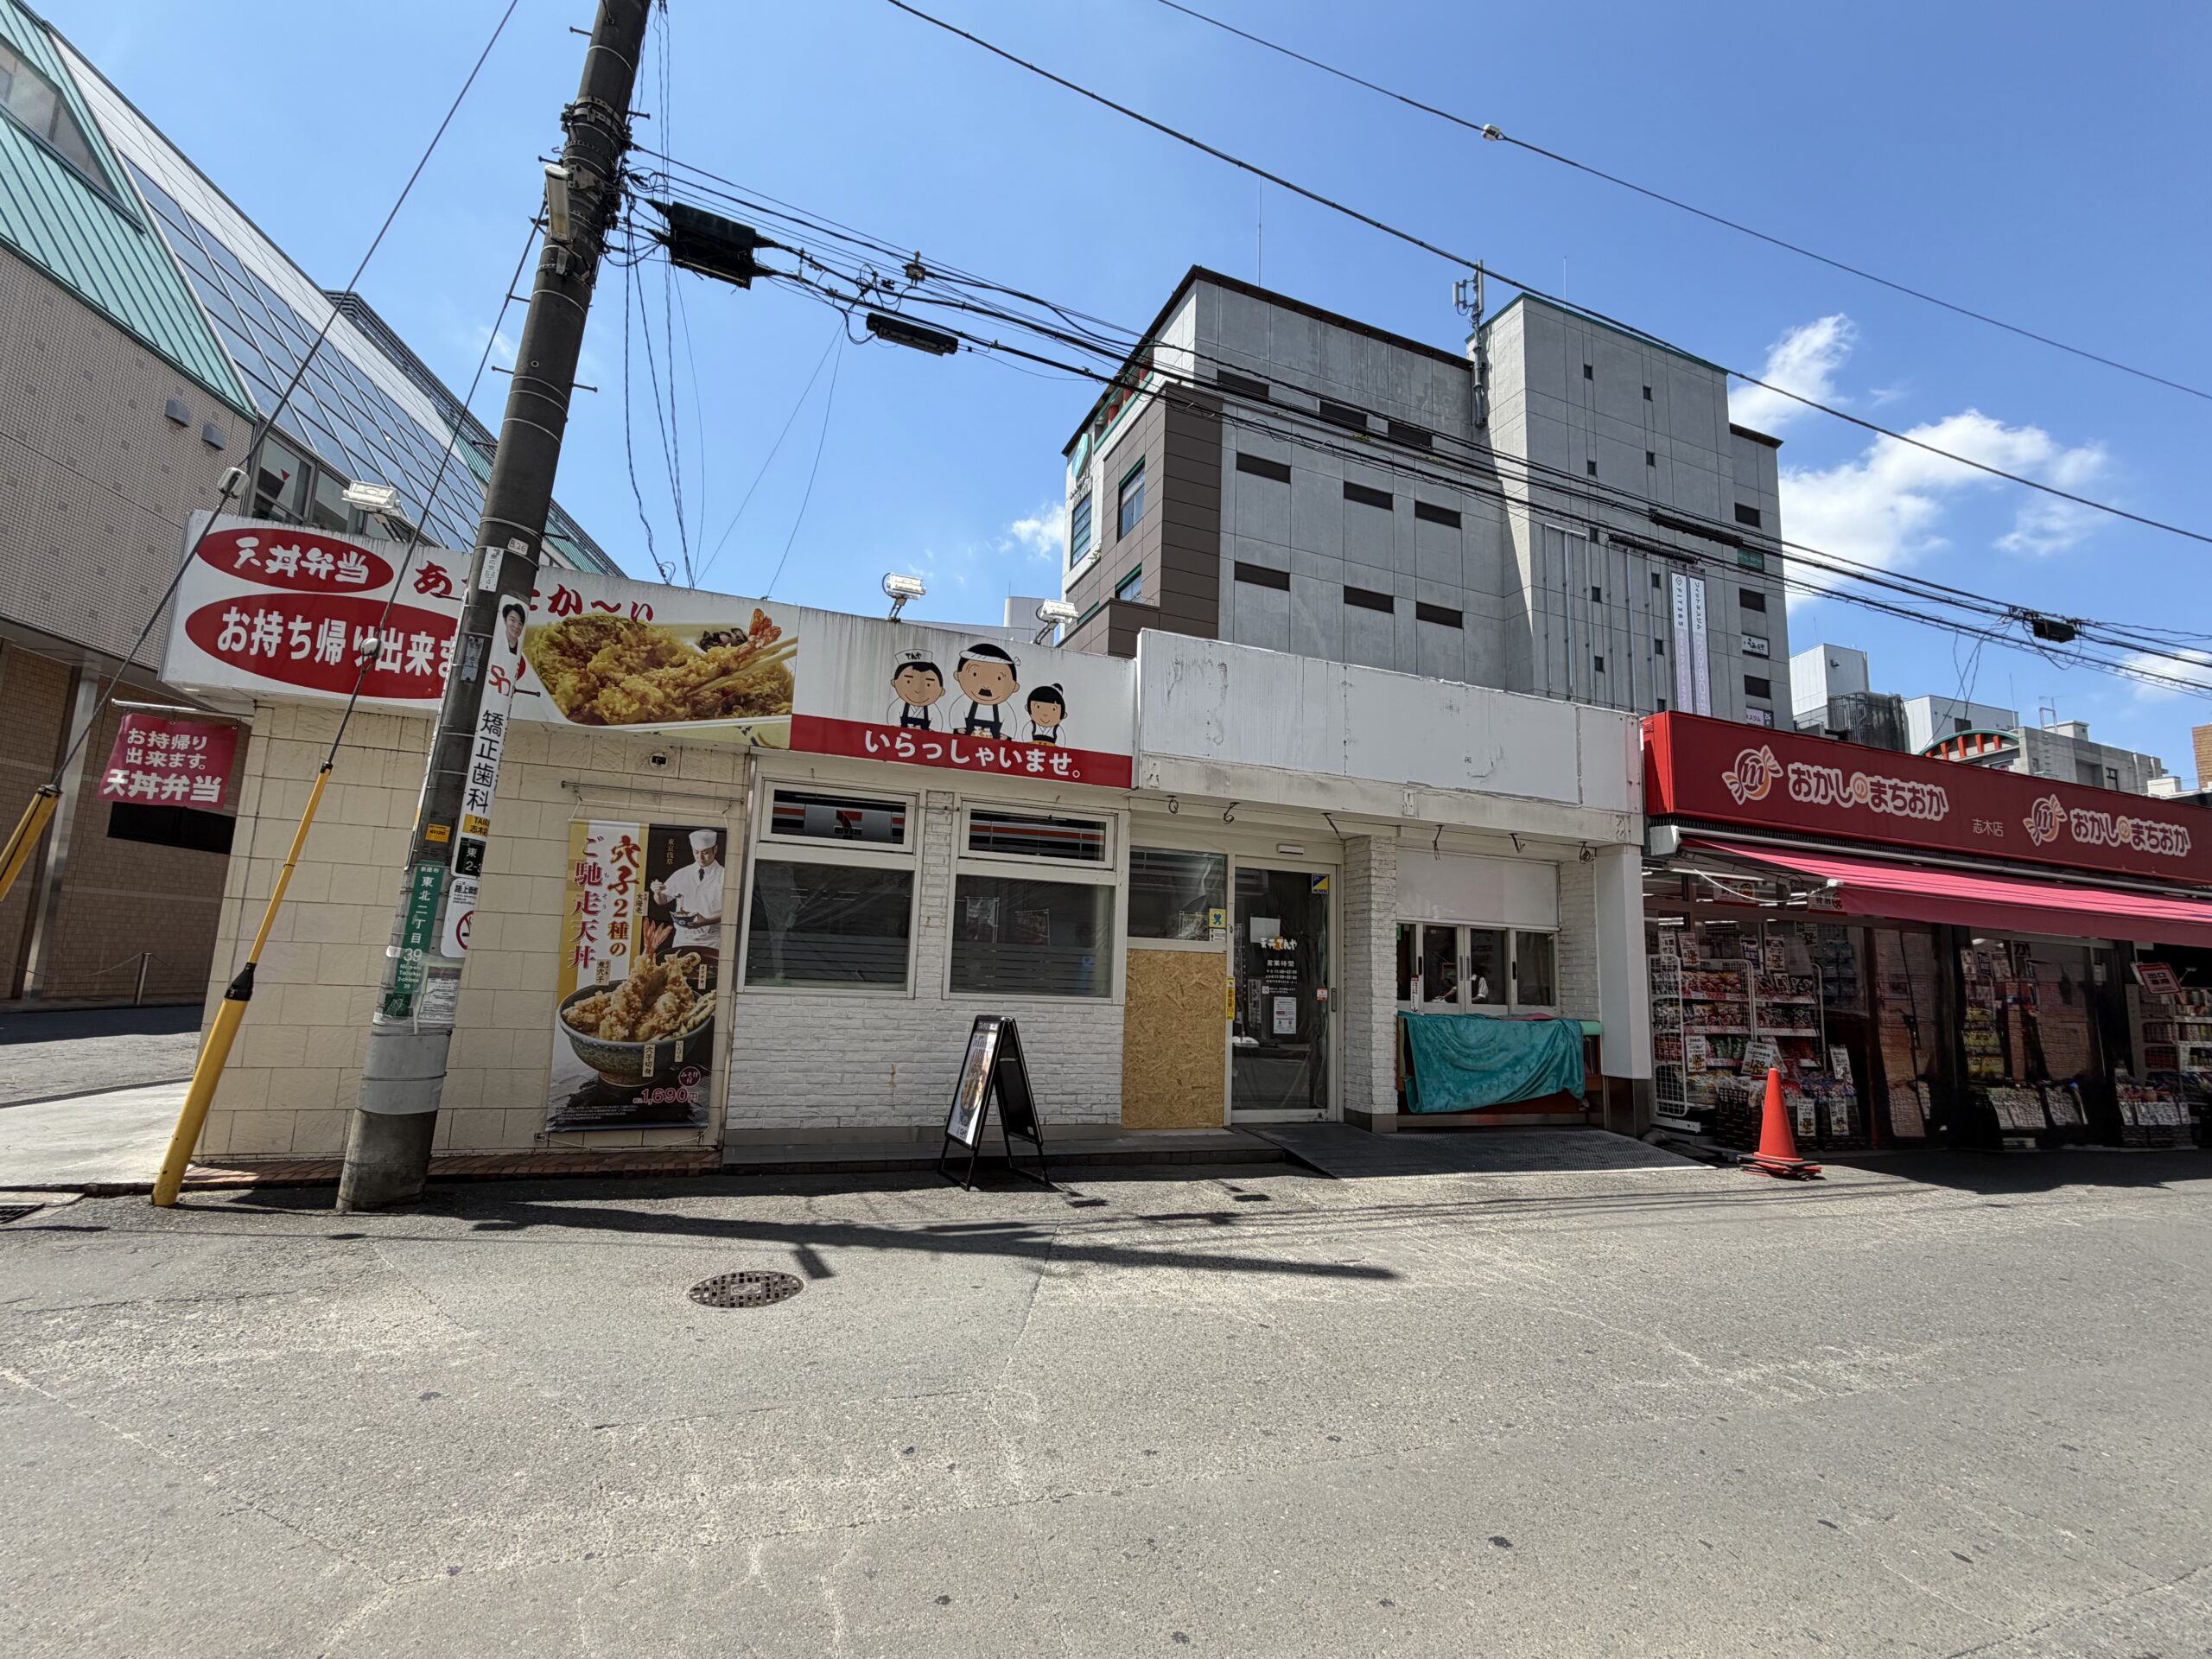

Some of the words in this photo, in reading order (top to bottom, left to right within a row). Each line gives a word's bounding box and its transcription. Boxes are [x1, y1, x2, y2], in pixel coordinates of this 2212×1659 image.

[233, 536, 371, 584] 天丼弁当
[125, 747, 207, 770] 出来ます。
[126, 728, 207, 750] お持帰り
[466, 709, 504, 814] 矯正歯科
[865, 729, 1081, 778] いらっしゃいませ。
[103, 768, 222, 803] 天丼弁当
[1788, 762, 1948, 821] おかしのまちおか
[1973, 818, 2004, 837] 志木店
[2070, 808, 2191, 857] おかしのまちおか
[410, 876, 435, 944] 東北二丁目
[567, 836, 605, 969] ご馳走天丼
[607, 835, 642, 957] 穴子2種の
[403, 947, 423, 963] 39
